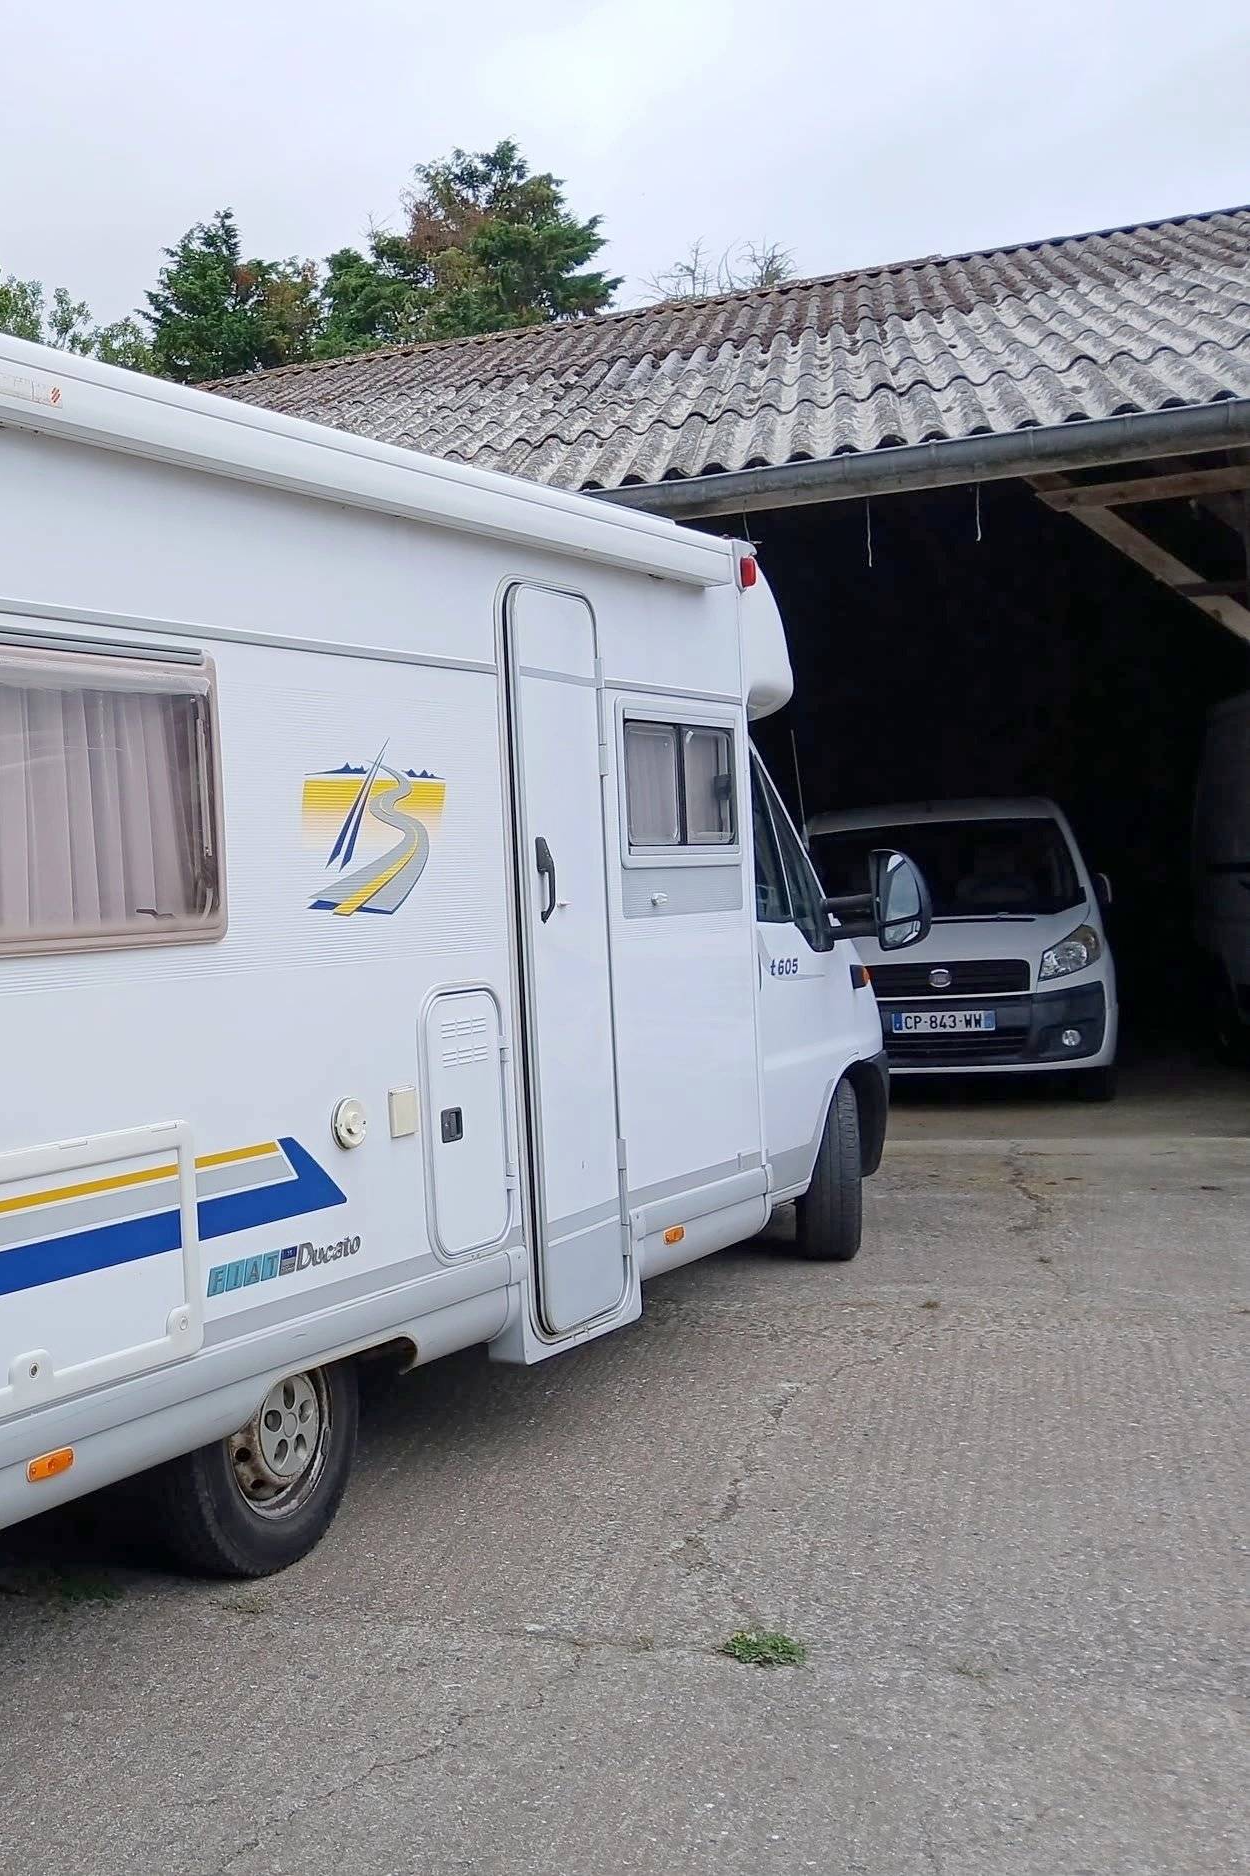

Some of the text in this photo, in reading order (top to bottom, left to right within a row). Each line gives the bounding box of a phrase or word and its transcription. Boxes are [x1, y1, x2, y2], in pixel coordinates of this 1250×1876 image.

[905, 1013, 982, 1030] CP-843-WW
[207, 1249, 280, 1297] FIAT
[296, 1235, 361, 1272] Ducato
